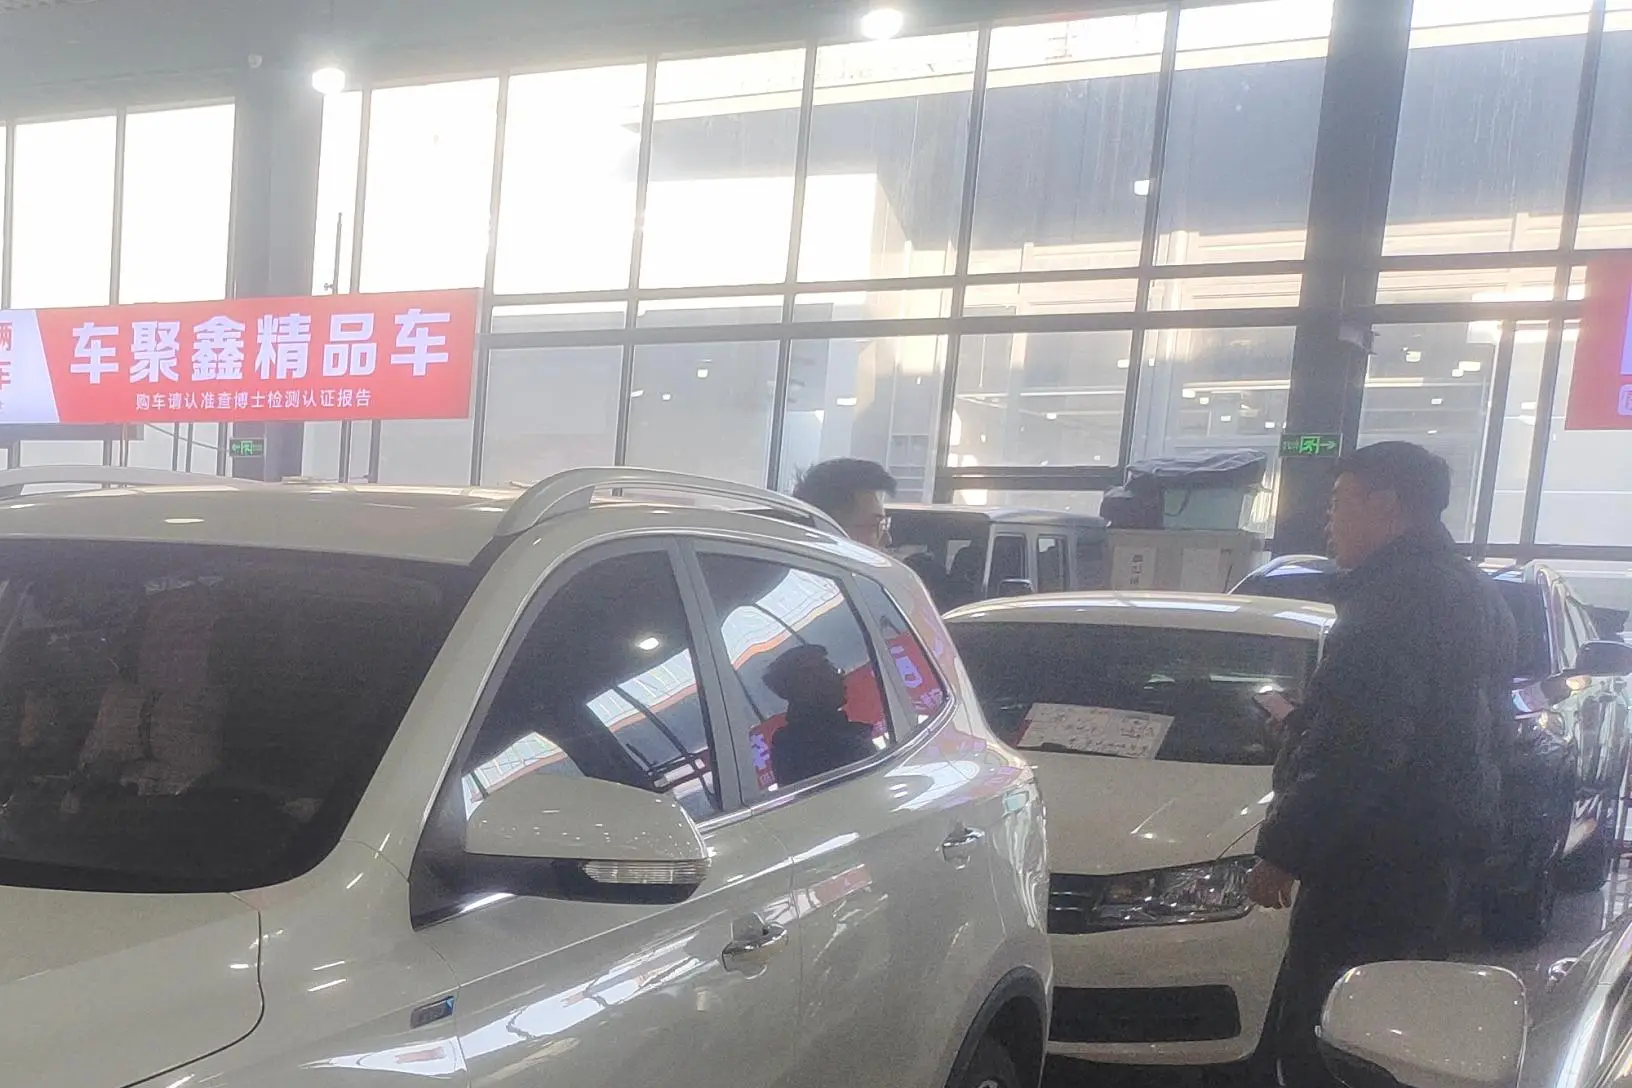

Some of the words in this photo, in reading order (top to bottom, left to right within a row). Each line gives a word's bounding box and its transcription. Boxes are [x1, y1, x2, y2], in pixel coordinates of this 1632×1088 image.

[70, 308, 451, 384] 车聚鑫精品车
[135, 389, 372, 411] 购车请认准查博士检测认证报告
